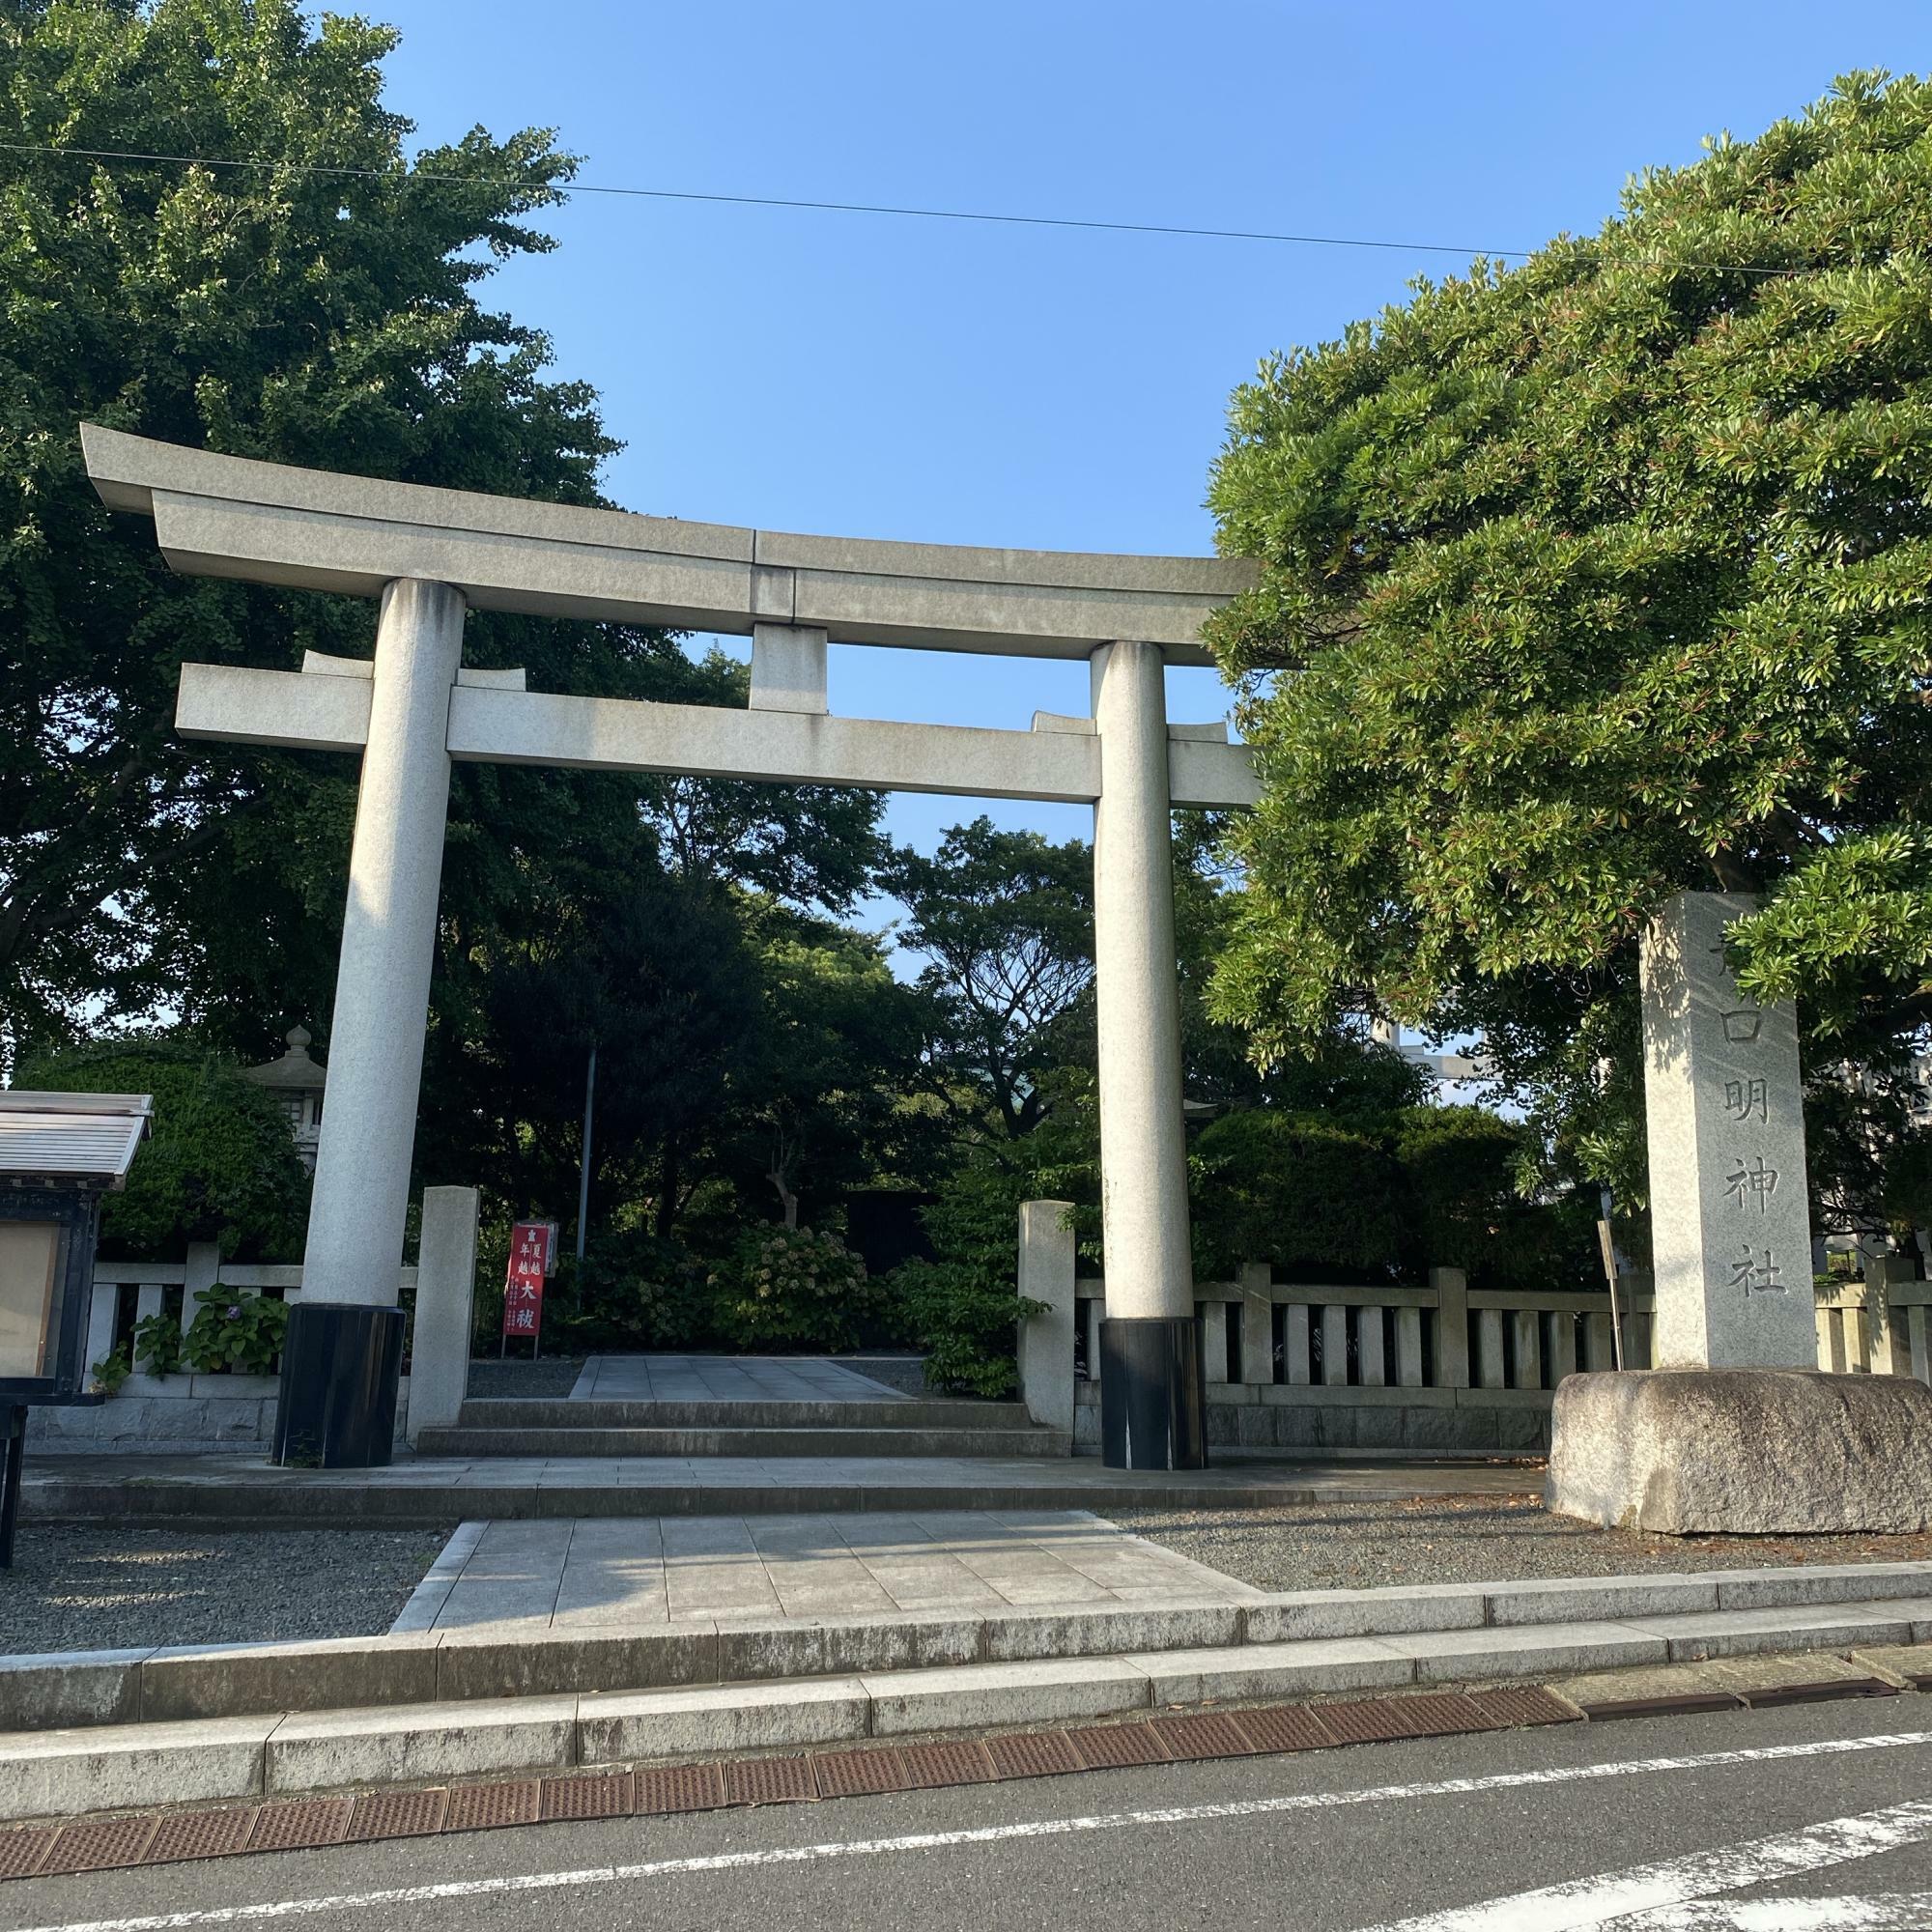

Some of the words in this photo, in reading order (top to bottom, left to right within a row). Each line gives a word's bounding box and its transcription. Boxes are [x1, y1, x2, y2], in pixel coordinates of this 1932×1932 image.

[518, 1243, 530, 1276] 年越
[530, 1243, 542, 1276] 夏越
[517, 1281, 536, 1328] 大祓
